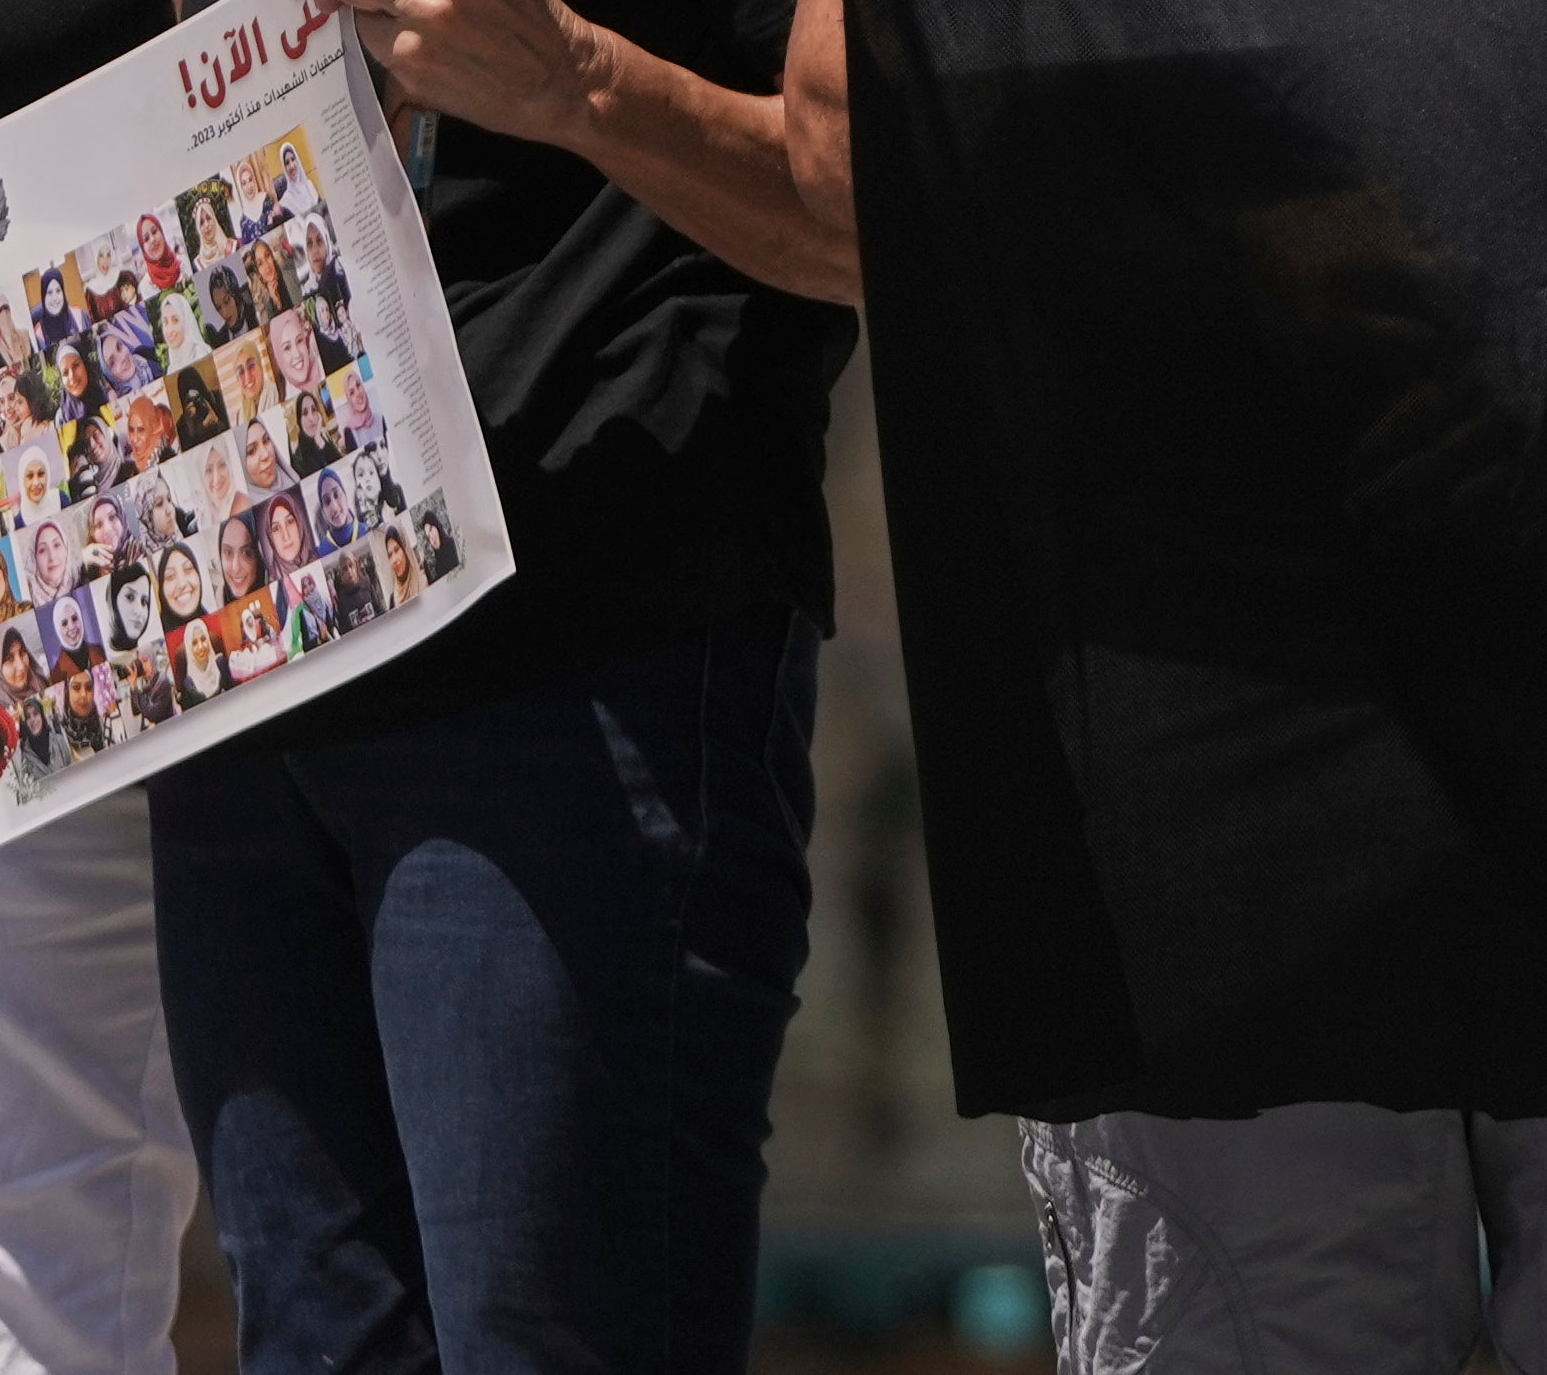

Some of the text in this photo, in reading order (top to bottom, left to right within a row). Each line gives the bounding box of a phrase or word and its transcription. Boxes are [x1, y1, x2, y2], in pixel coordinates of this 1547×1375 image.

[178, 15, 268, 109] الآن!
[264, 68, 308, 106] الشهيدات
[218, 103, 244, 138] أكتوبر
[246, 100, 261, 118] منذ
